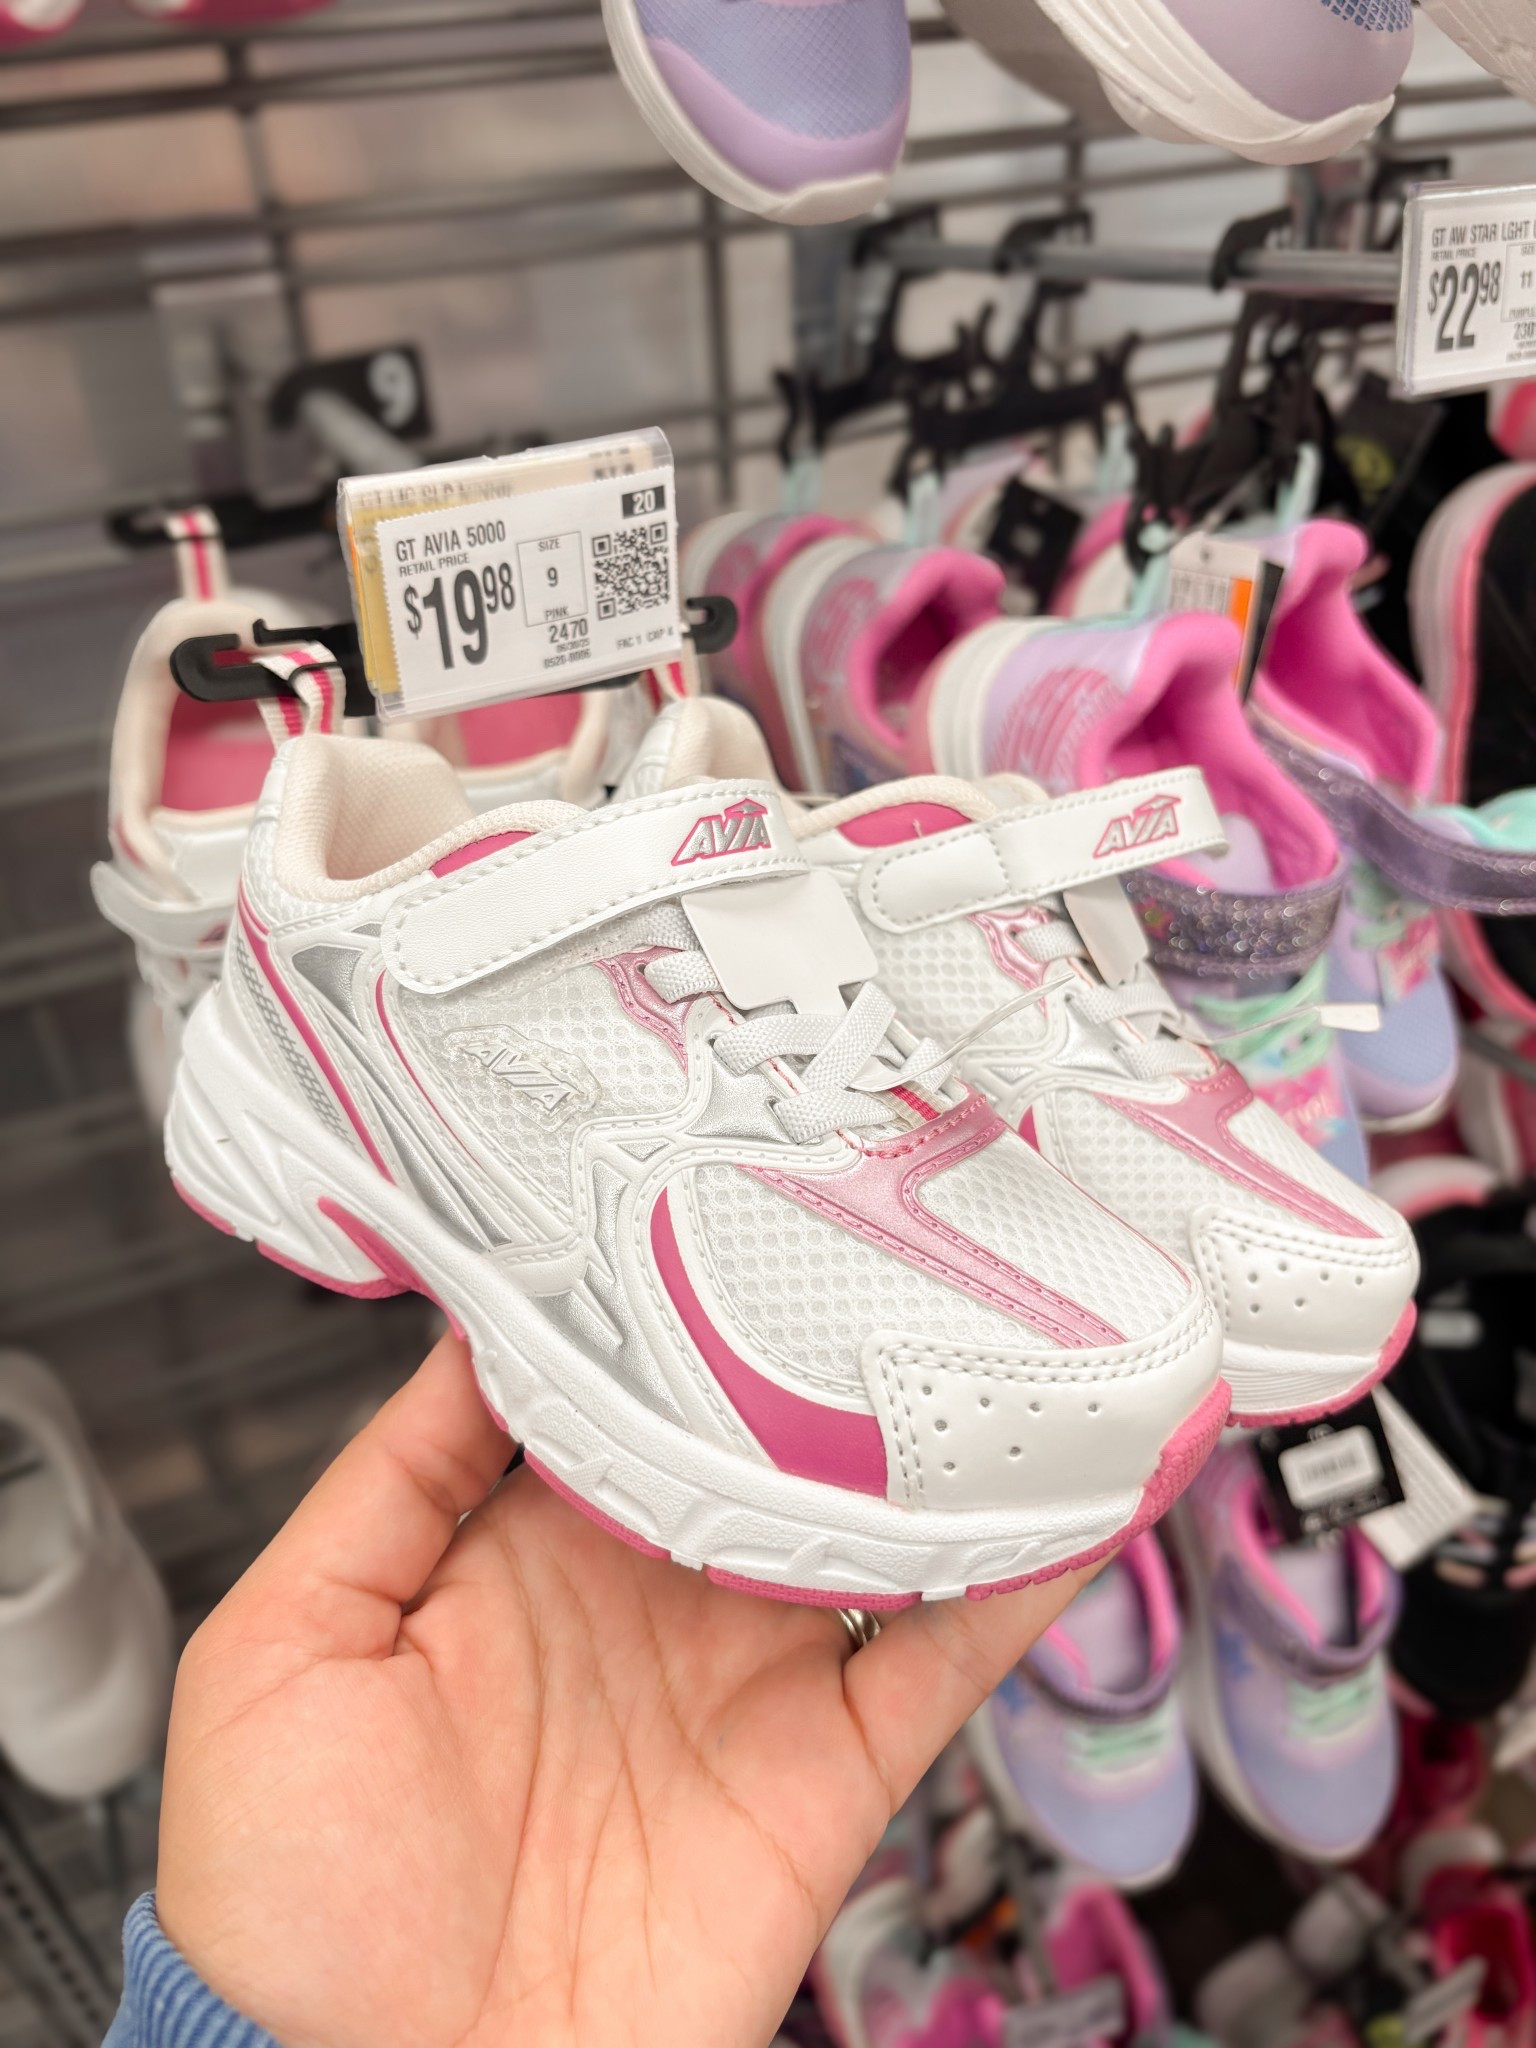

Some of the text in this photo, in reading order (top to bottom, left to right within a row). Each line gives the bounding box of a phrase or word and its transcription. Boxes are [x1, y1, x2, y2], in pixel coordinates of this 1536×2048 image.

[1432, 226, 1446, 248] GT
[1449, 224, 1467, 246] AW
[1470, 222, 1497, 244] STAR
[1501, 220, 1530, 241] LGHT
[1431, 246, 1476, 262] RETAIL PRICE
[1520, 270, 1533, 290] 11
[1513, 320, 1536, 341] 230
[368, 350, 418, 429] 9
[632, 489, 656, 515] 20
[396, 520, 506, 562] GT AVIA 5000
[538, 537, 561, 552] SIZE
[399, 553, 470, 577] RETAIL PRICE
[547, 567, 558, 587] 9
[544, 606, 569, 620] PINK
[549, 618, 589, 643] 2470
[671, 798, 772, 867] AVIA
[1092, 793, 1181, 859] AVIA
[458, 1040, 586, 1114] AVIA
